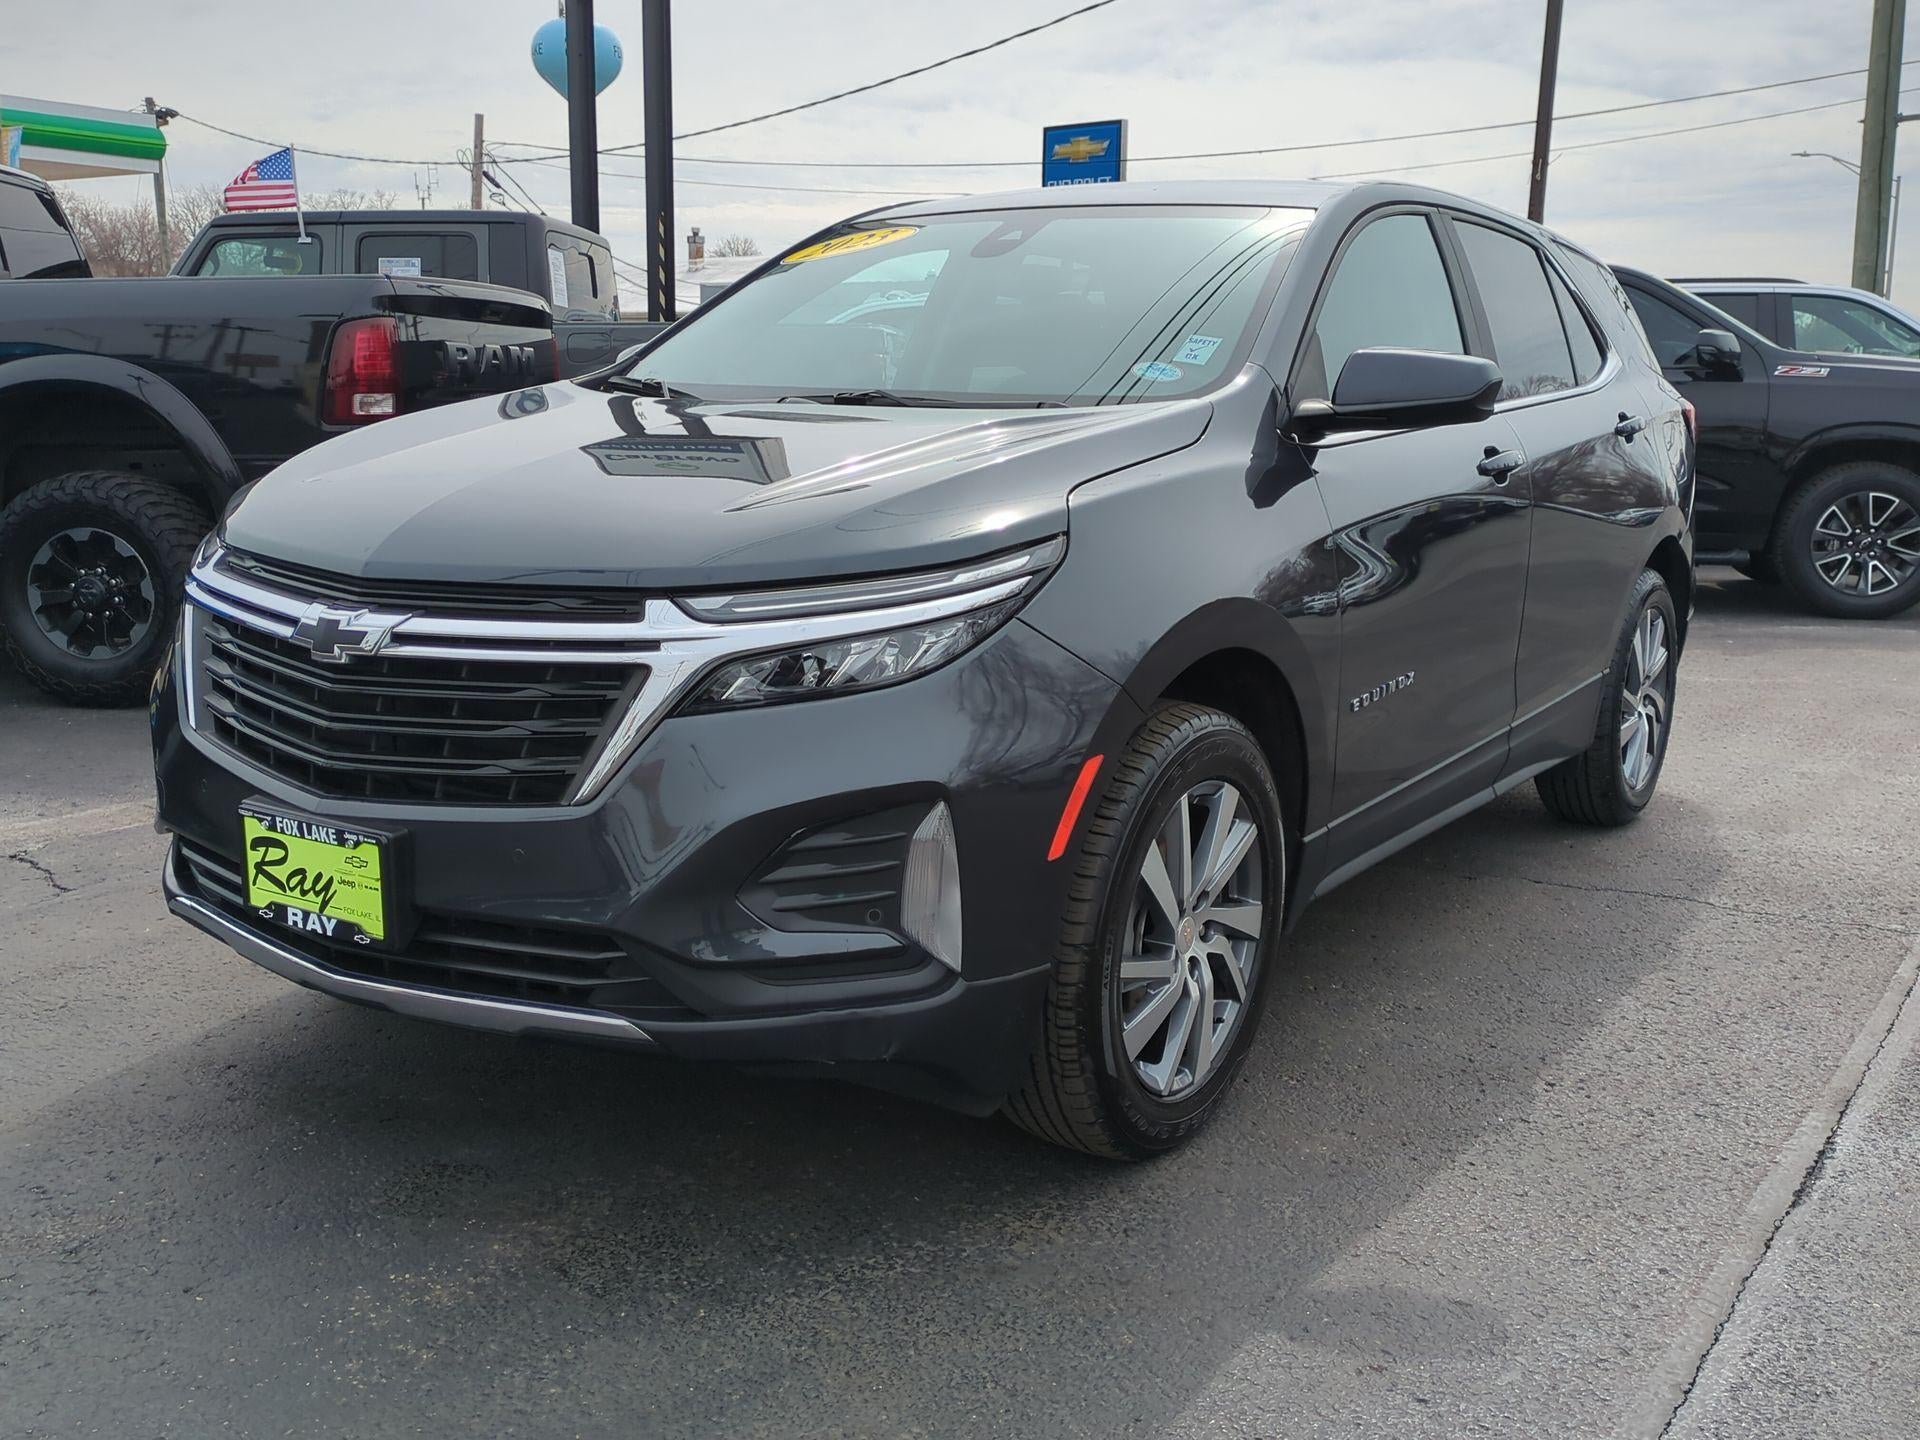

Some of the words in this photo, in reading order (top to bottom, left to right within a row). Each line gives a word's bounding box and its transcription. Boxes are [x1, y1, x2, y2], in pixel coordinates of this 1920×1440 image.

[1188, 337, 1218, 347] SAFETY
[445, 341, 535, 380] RAM
[1351, 670, 1415, 713] EQUINOX
[275, 816, 301, 837] FOX
[302, 822, 338, 845] LAKE
[250, 836, 338, 914] Ray
[337, 876, 357, 890] Jeep
[287, 906, 338, 936] RAY
